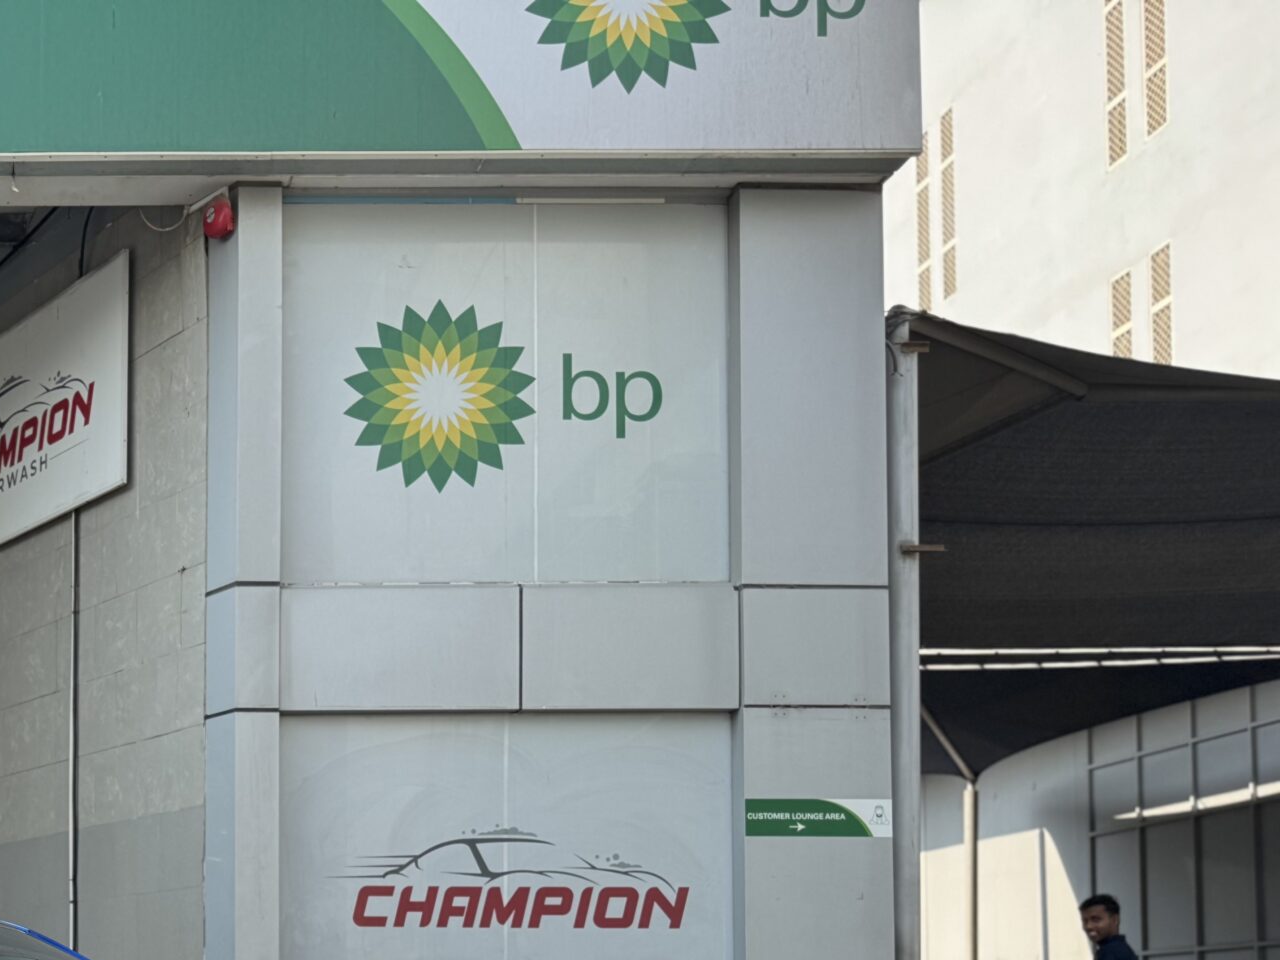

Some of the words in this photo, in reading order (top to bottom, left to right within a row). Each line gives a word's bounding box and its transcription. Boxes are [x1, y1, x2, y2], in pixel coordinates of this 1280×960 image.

[562, 353, 663, 439] bp
[747, 812, 790, 820] CUSTOMER
[792, 812, 824, 820] LOUNGE
[825, 812, 846, 820] AREA
[352, 885, 690, 929] CHAMPION
